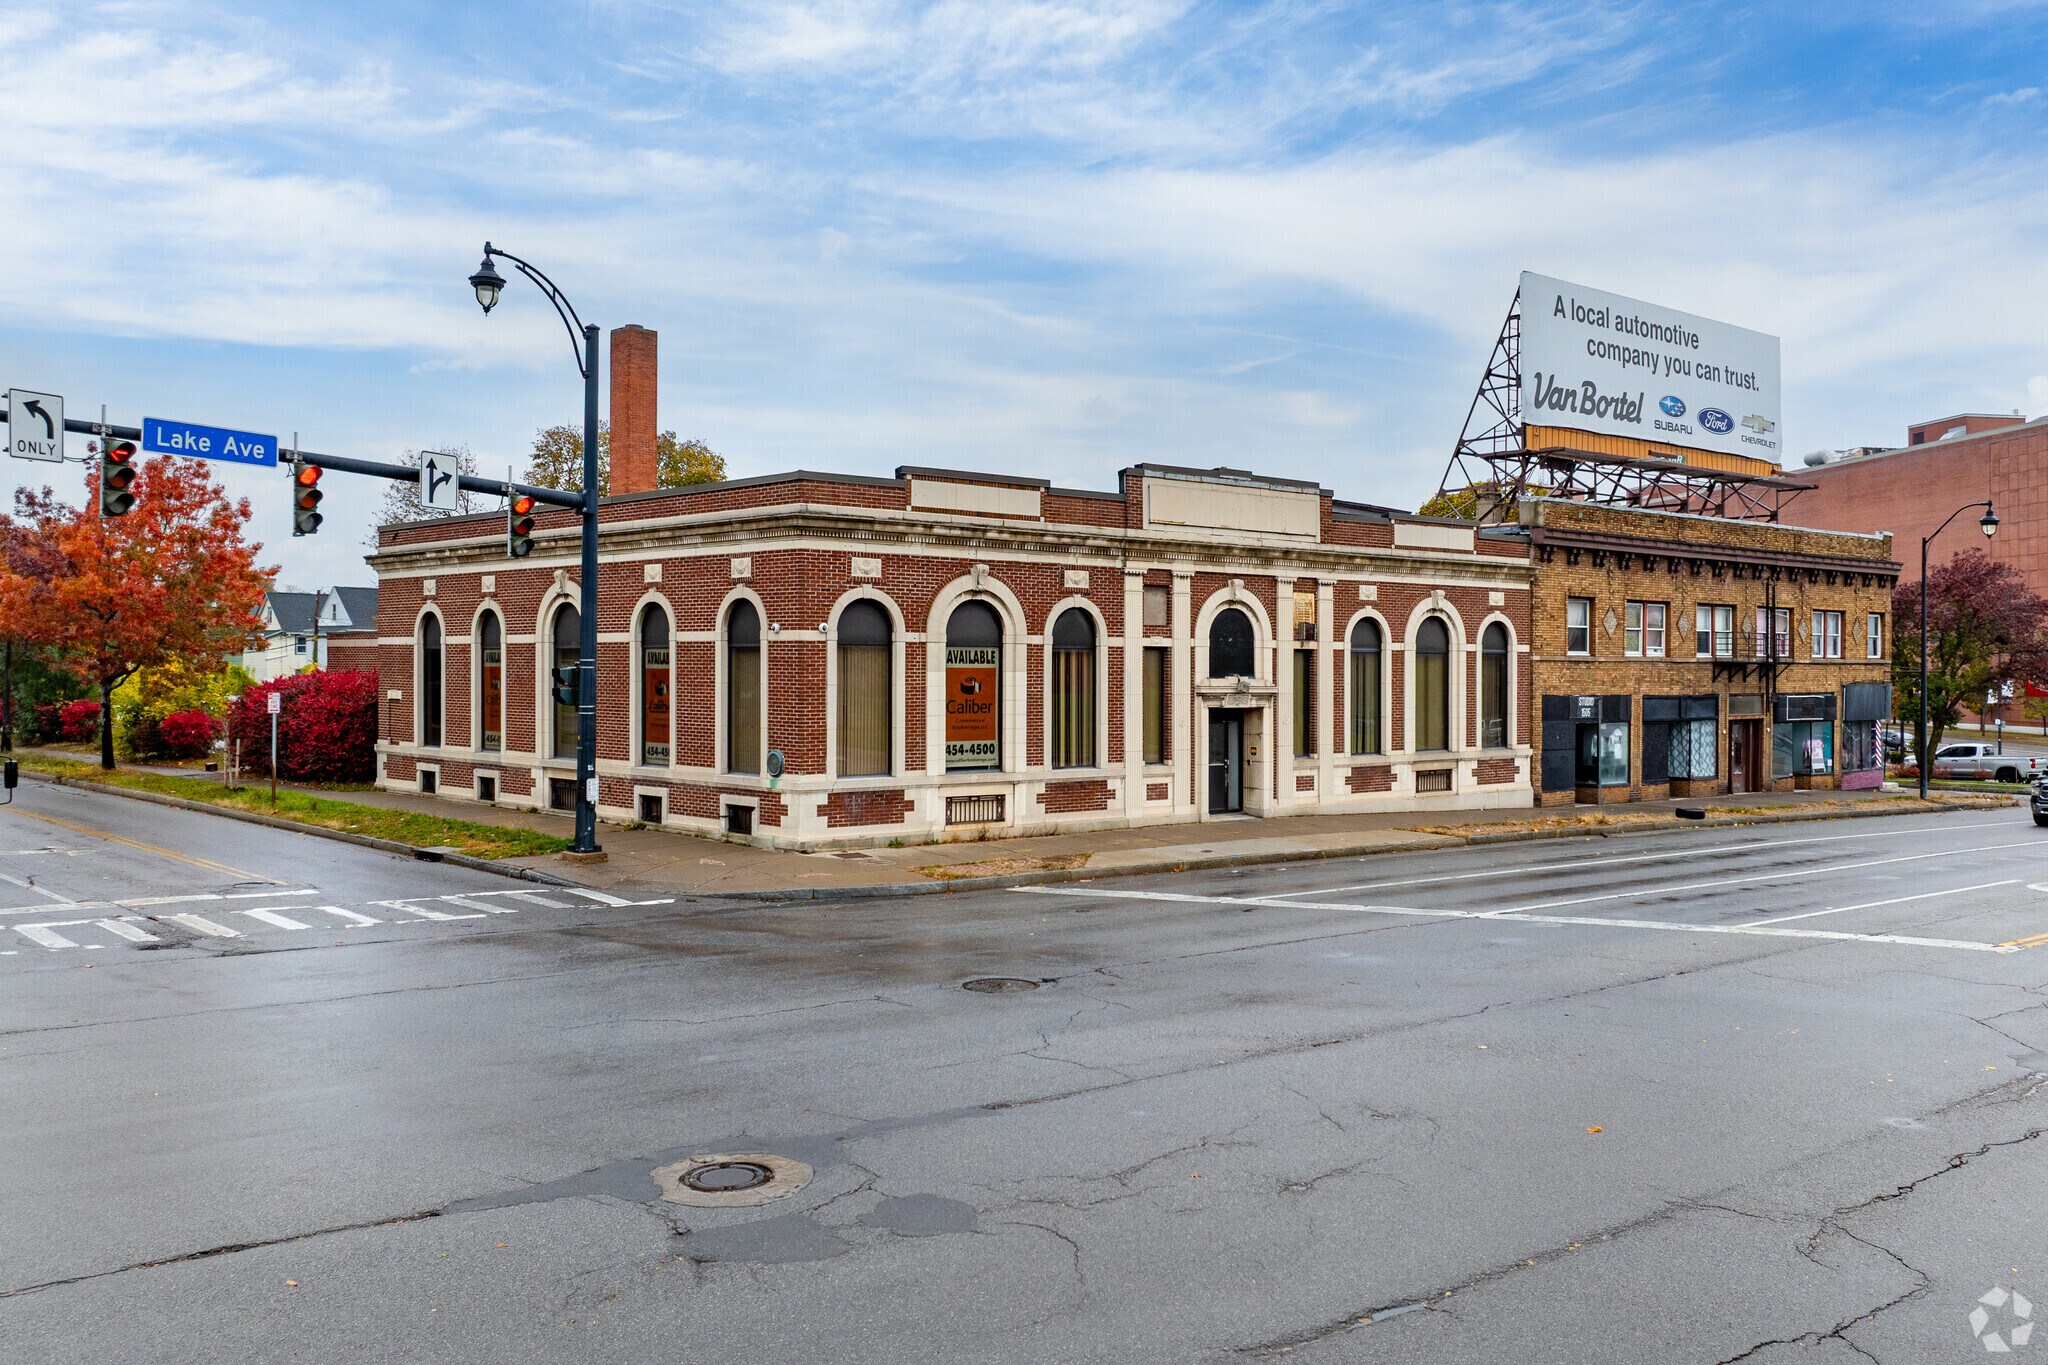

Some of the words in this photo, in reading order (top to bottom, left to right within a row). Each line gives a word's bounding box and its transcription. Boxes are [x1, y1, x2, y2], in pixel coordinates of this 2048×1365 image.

[1554, 295, 1566, 318] A
[1571, 298, 1610, 329] local
[1615, 314, 1699, 350] automotive
[1587, 338, 1660, 375] company
[1664, 355, 1691, 377] you
[1696, 363, 1721, 383] can
[1725, 365, 1760, 391] trust.
[1654, 419, 1693, 435] SUBARU
[1704, 411, 1728, 431] Ford
[17, 439, 56, 456] ONLY
[157, 427, 211, 452] Lake
[223, 436, 265, 459] Ave
[1741, 434, 1777, 449] CHEVROLET
[946, 649, 996, 665] AVAILABLE
[946, 699, 993, 714] Caliber
[946, 743, 996, 756] 454-4500
